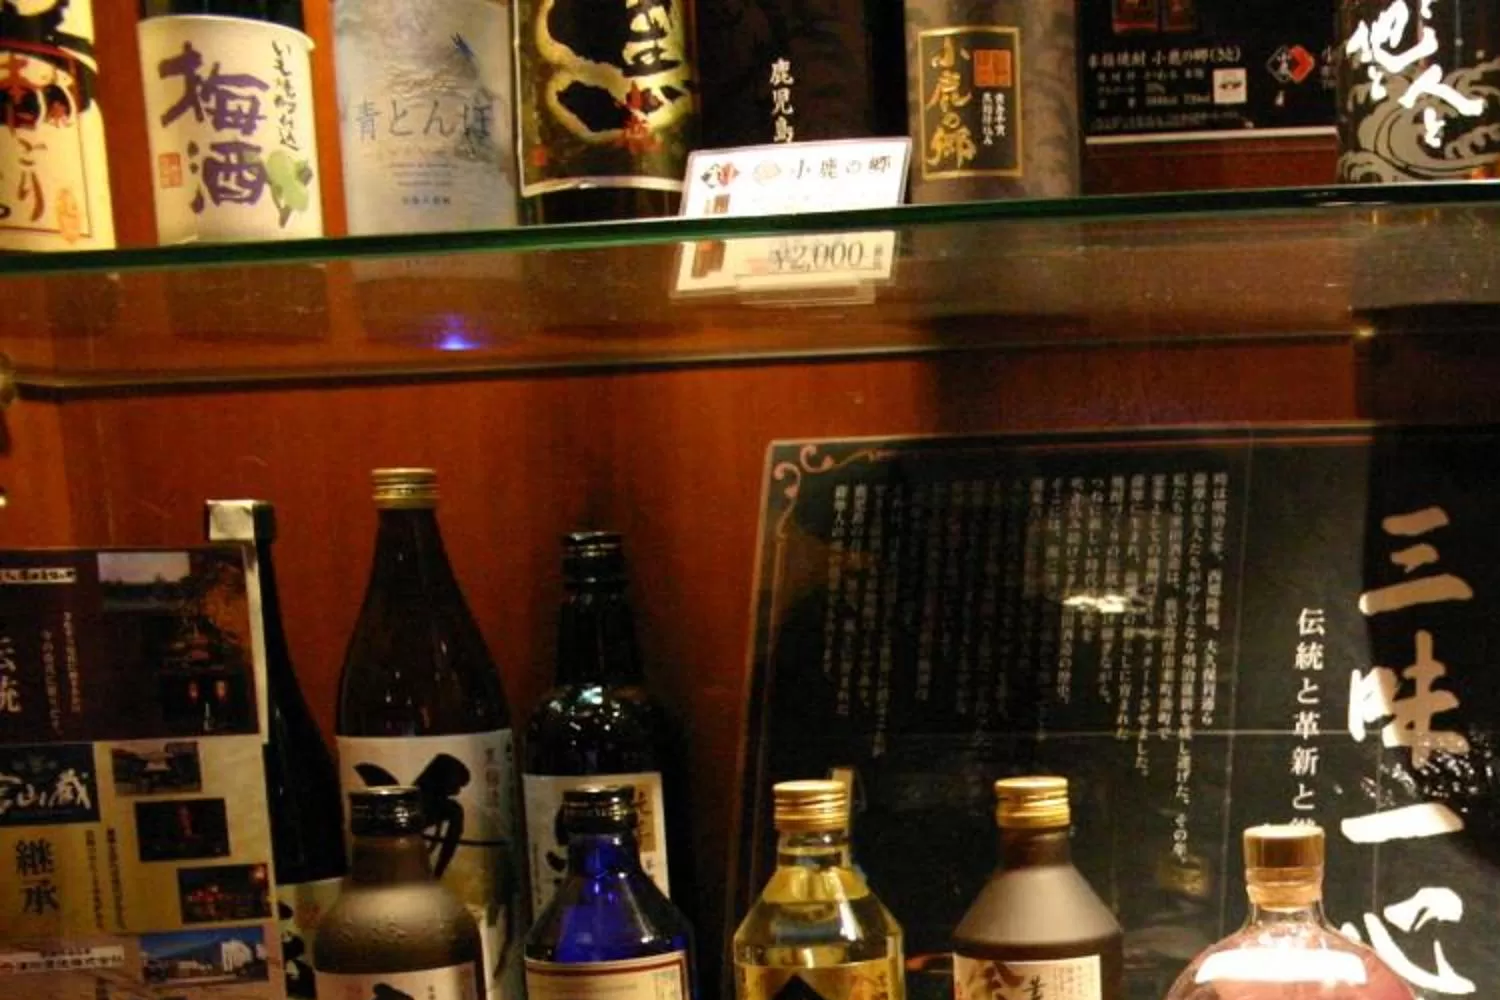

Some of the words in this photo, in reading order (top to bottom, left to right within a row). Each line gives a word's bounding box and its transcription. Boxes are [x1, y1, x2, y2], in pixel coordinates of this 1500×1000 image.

[159, 40, 270, 214] 梅酒
[770, 57, 795, 143] 鹿児島
[926, 36, 978, 168] 小鹿の郷
[1289, 606, 1326, 828] 伝統と革新と
